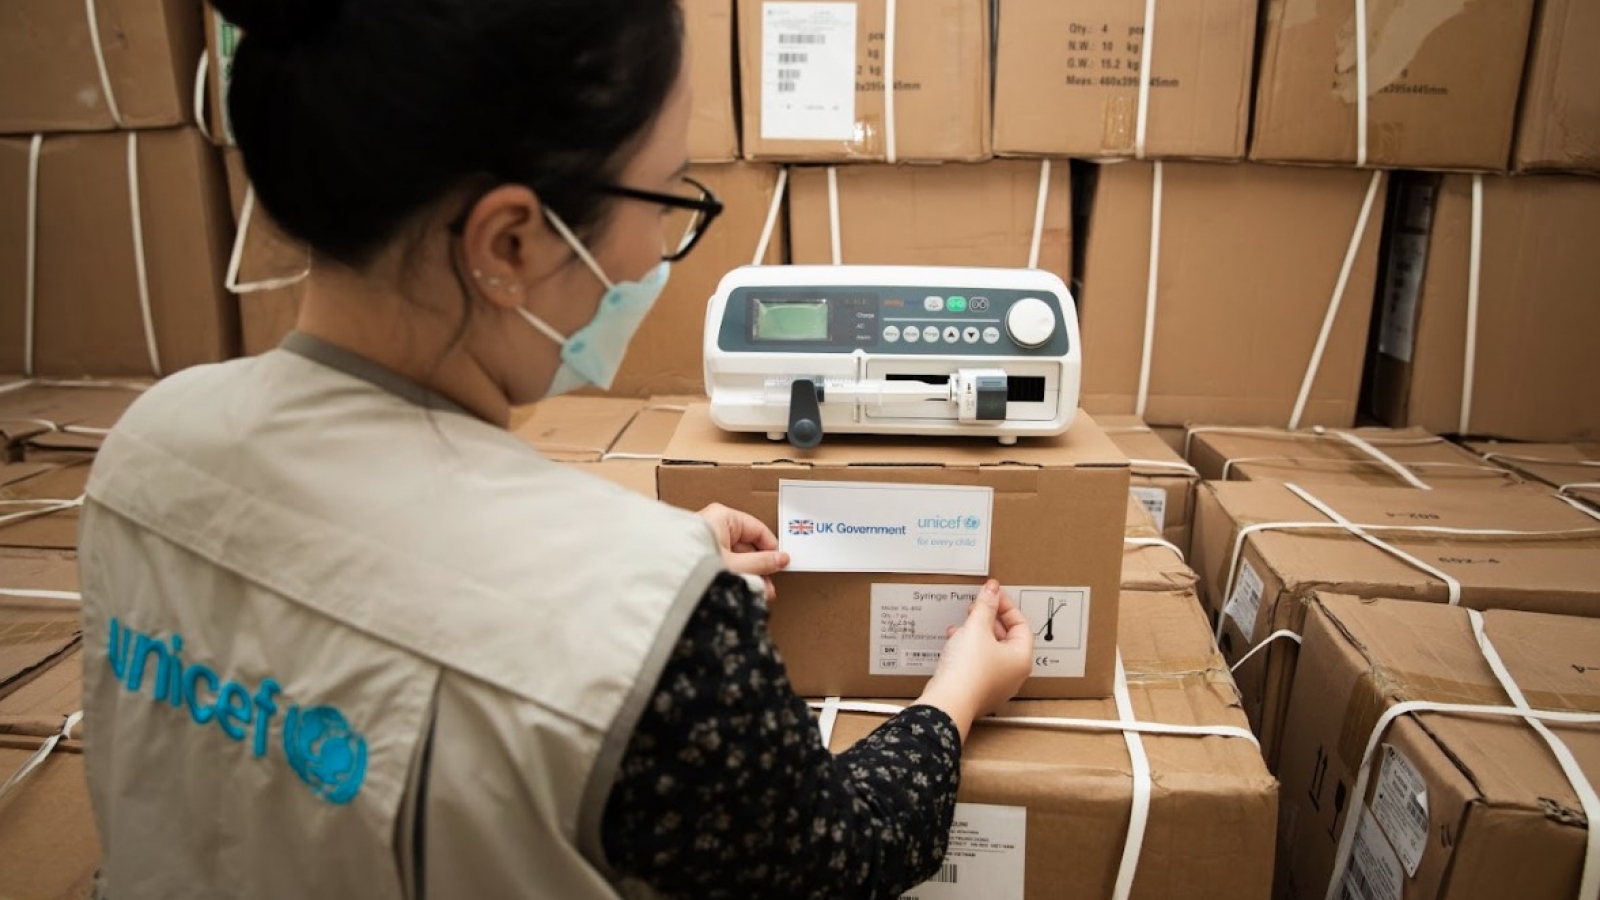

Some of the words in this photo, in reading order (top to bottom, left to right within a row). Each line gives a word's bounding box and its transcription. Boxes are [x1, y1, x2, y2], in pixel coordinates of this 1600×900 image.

[1126, 42, 1139, 54] kg
[1127, 60, 1140, 72] kg
[917, 515, 962, 529] unicef
[816, 522, 834, 534] UK
[836, 523, 907, 535] Government
[917, 537, 929, 546] for
[930, 539, 953, 548] every
[955, 537, 976, 547] child
[913, 591, 948, 602] Syringe
[950, 591, 978, 602] Pump
[108, 616, 282, 759] unicef
